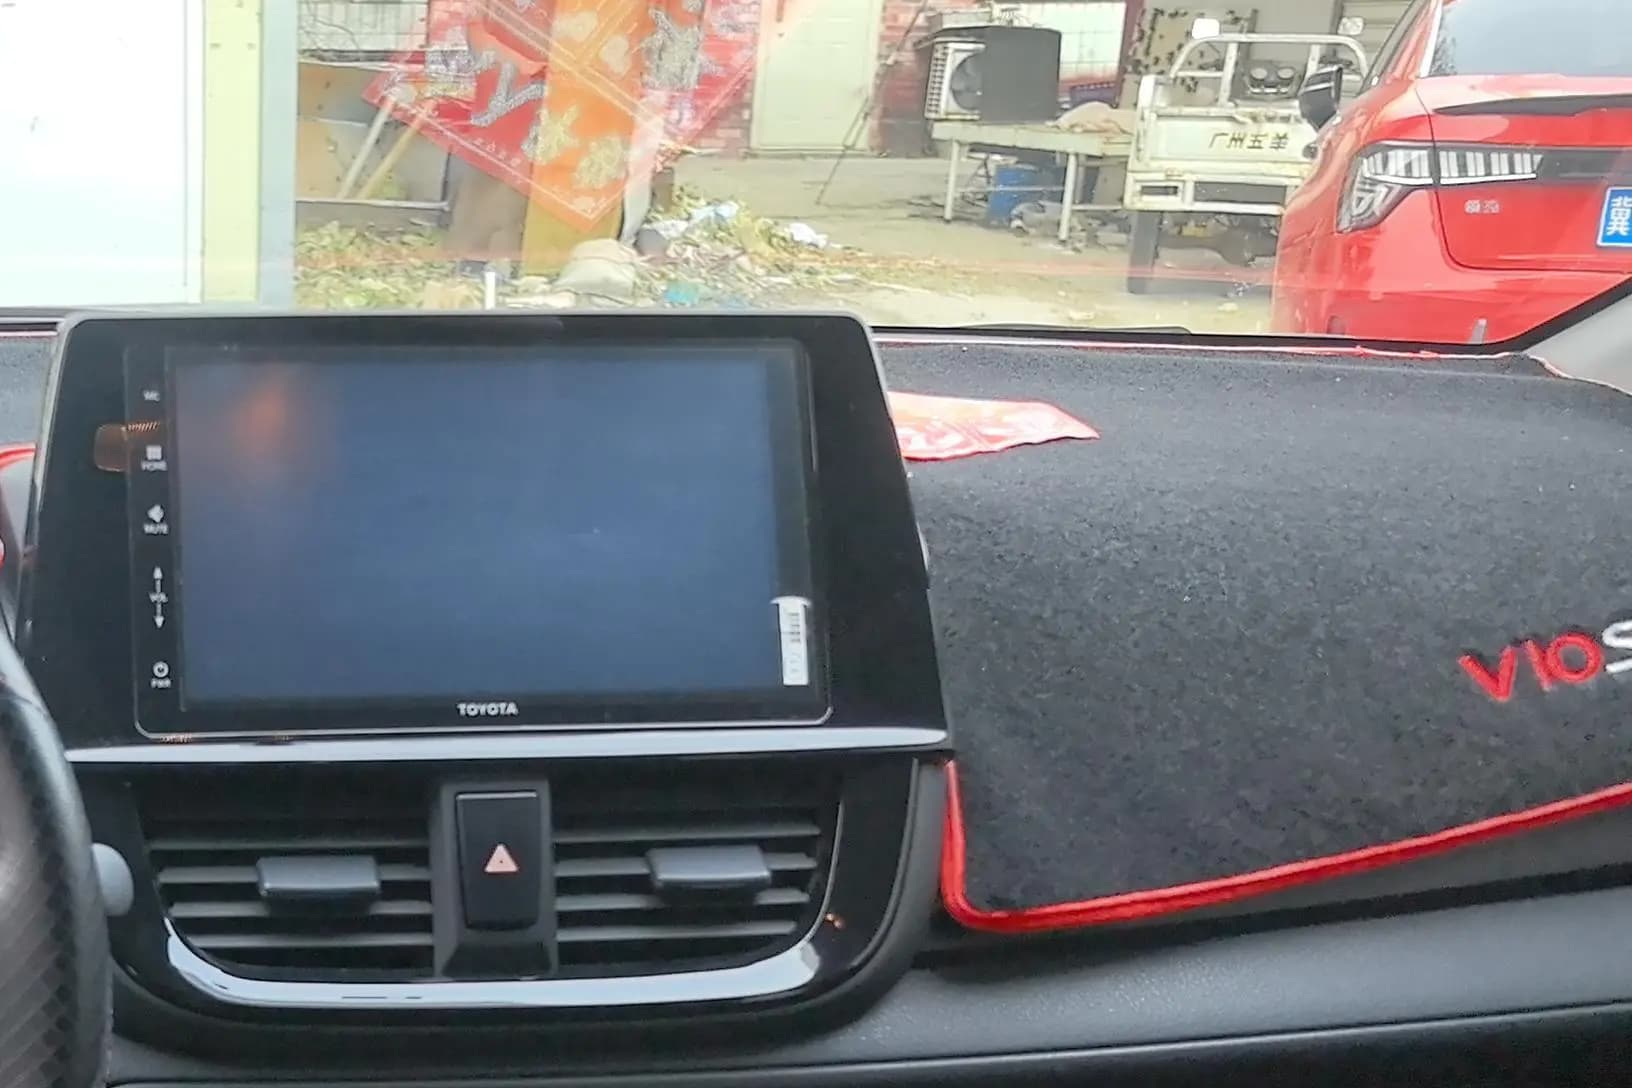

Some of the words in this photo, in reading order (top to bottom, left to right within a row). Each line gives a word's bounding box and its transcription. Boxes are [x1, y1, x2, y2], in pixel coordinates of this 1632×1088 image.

[1208, 132, 1289, 150] 广州五羊
[457, 702, 518, 716] TOYOTA
